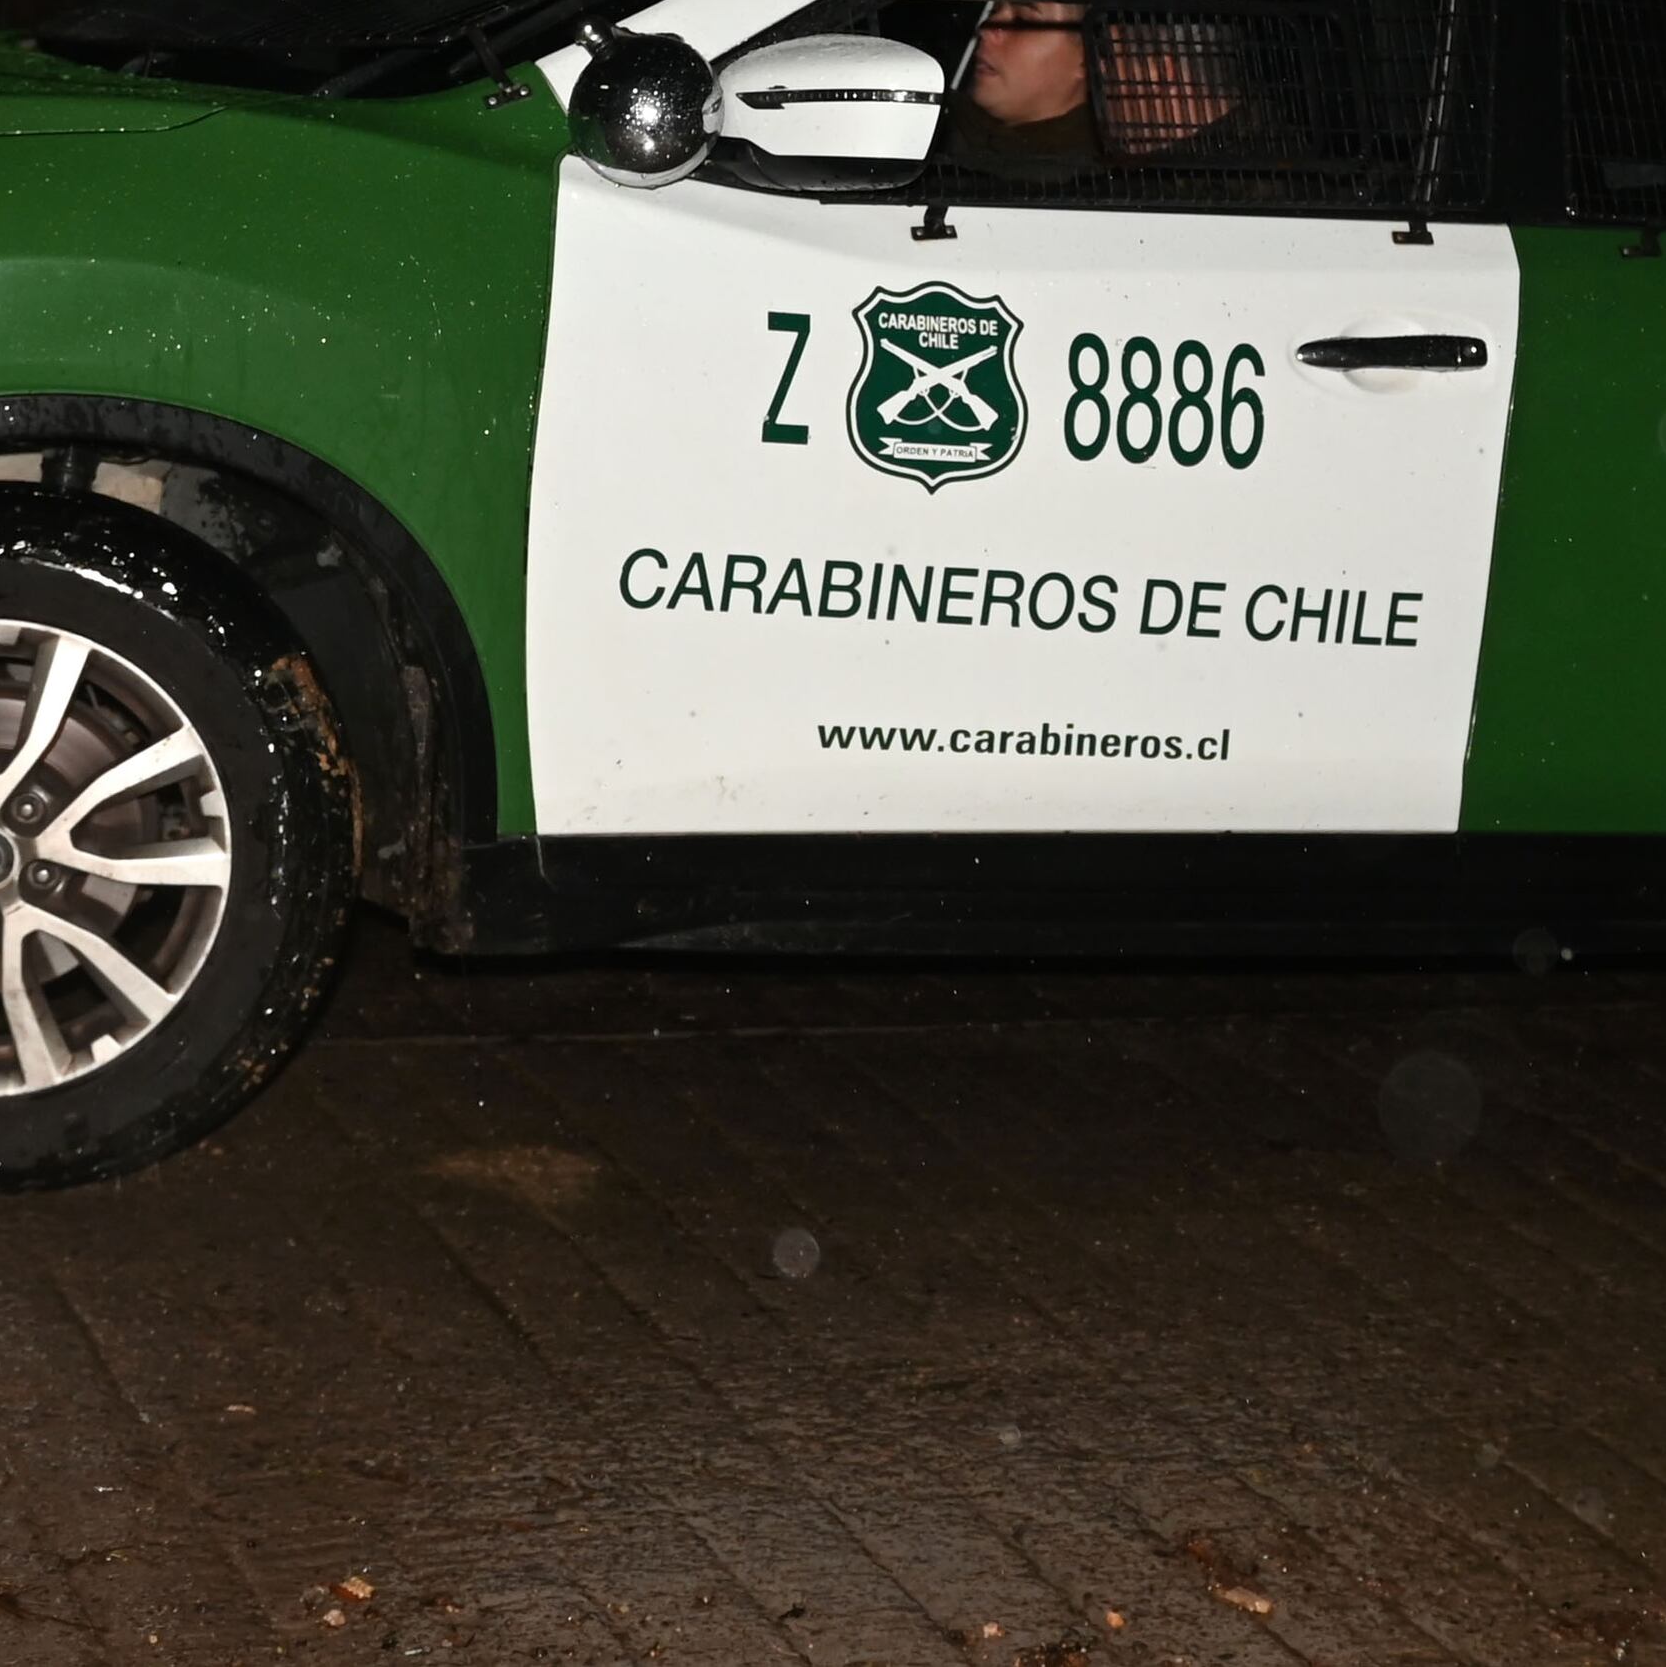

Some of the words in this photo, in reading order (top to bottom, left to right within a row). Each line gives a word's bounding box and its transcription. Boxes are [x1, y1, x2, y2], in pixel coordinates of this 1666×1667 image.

[878, 312, 977, 335] CARABINEROS
[979, 319, 998, 336] DE
[919, 332, 959, 350] CHILE
[761, 311, 811, 445] Z
[1064, 332, 1266, 470] 8886
[896, 446, 929, 456] ORDEN
[940, 447, 974, 458] PATRIA
[619, 548, 1118, 633] CARABINEROS
[1139, 578, 1227, 638] DE
[1245, 584, 1423, 647] CHILE
[817, 722, 1230, 761] www.carabineros.cl
